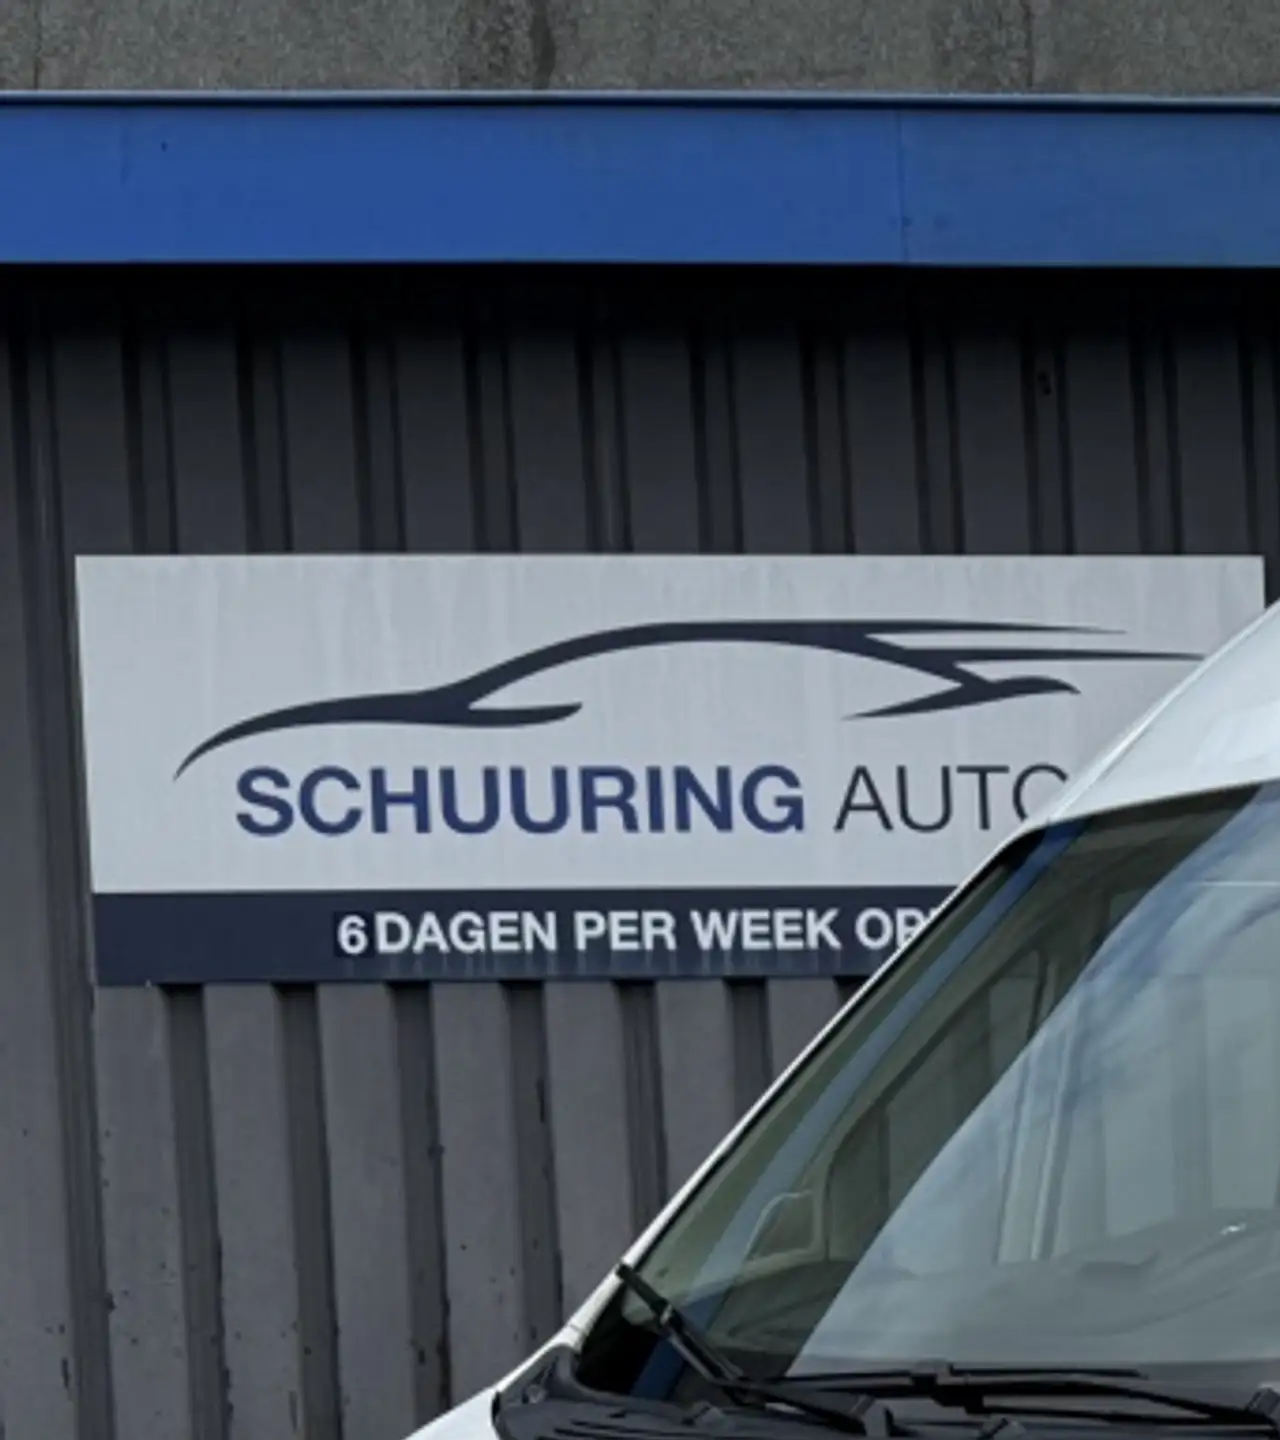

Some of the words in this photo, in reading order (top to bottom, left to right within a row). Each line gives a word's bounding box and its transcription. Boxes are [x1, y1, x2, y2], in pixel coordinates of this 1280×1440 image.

[236, 764, 805, 835] SCHUURING
[337, 914, 368, 956] 6
[376, 911, 557, 953] DAGEN
[574, 910, 677, 951] PER
[690, 906, 842, 950] WEEK
